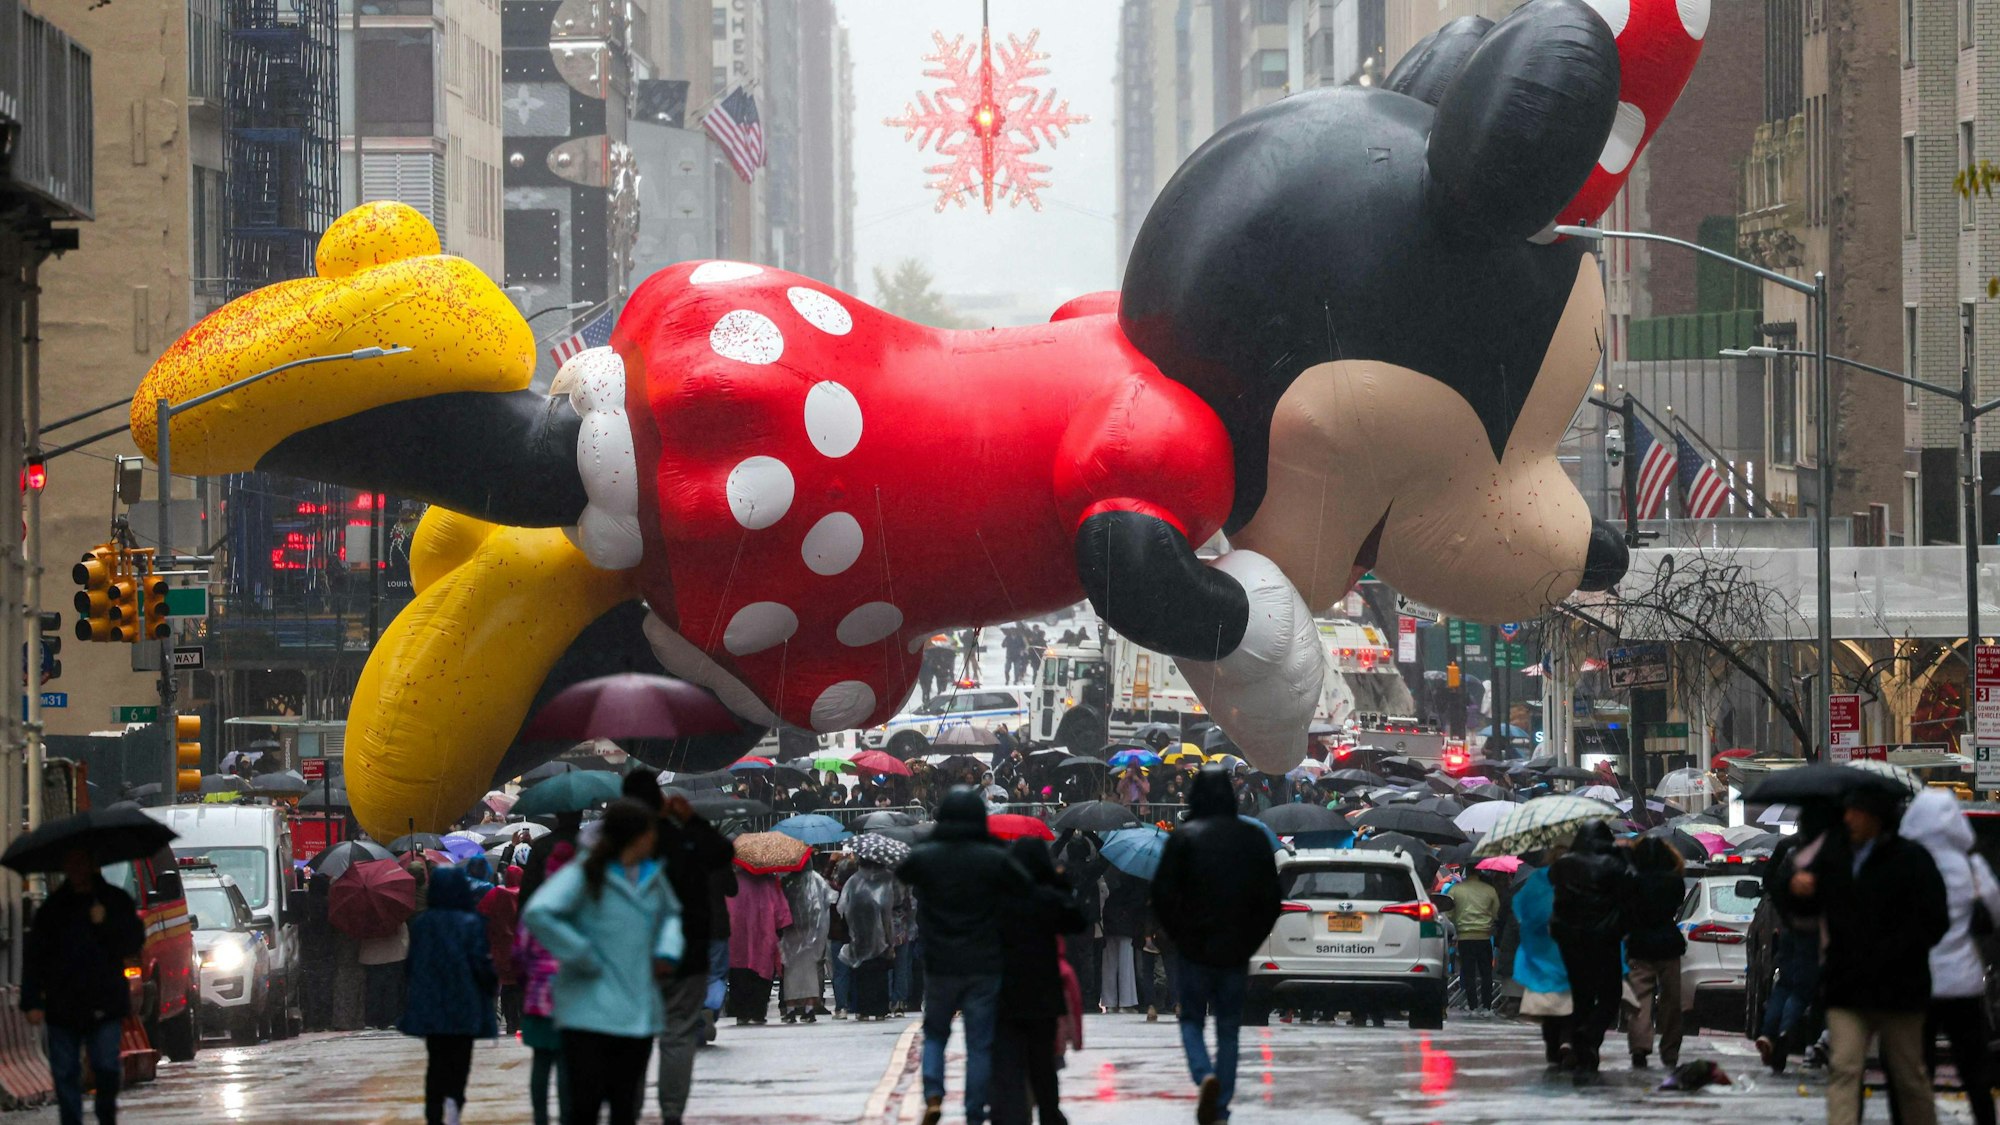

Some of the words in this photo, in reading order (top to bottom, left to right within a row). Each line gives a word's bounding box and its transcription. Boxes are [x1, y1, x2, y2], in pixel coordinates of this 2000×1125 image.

[387, 580, 408, 588] LOUIS
[174, 653, 196, 664] WAY
[1978, 688, 1987, 701] 3
[130, 708, 138, 721] 6
[1832, 732, 1839, 744] 3
[1979, 748, 1987, 760] 5
[1315, 943, 1375, 955] sanitation
